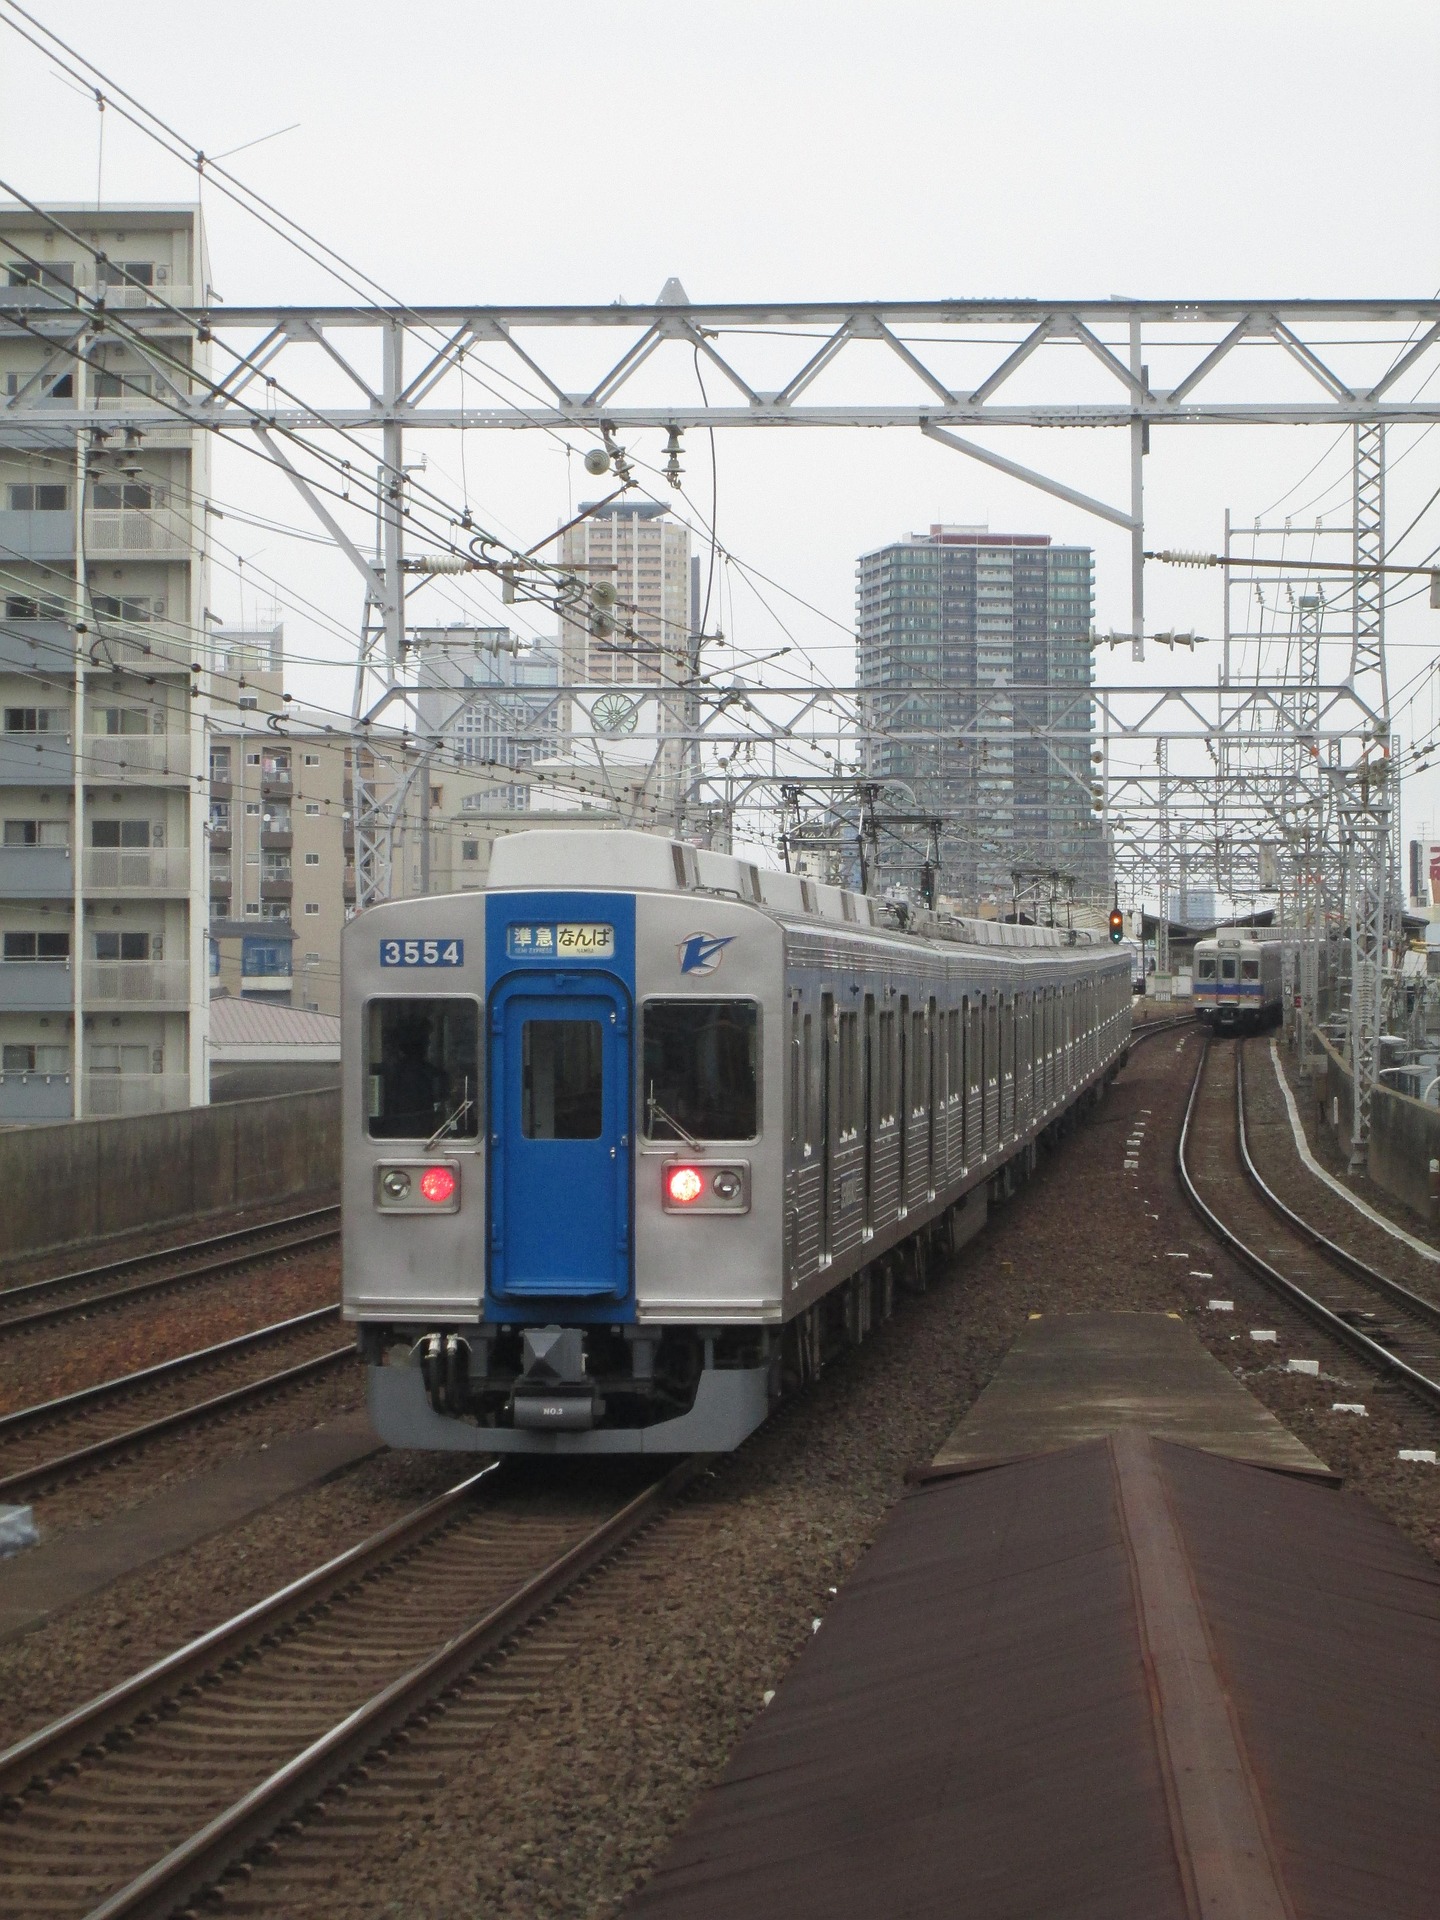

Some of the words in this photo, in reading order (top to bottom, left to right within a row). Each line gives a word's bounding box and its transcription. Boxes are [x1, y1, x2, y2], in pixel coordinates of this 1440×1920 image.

[514, 927, 553, 947] 準急
[558, 928, 612, 947] なんば
[385, 941, 459, 964] 3554
